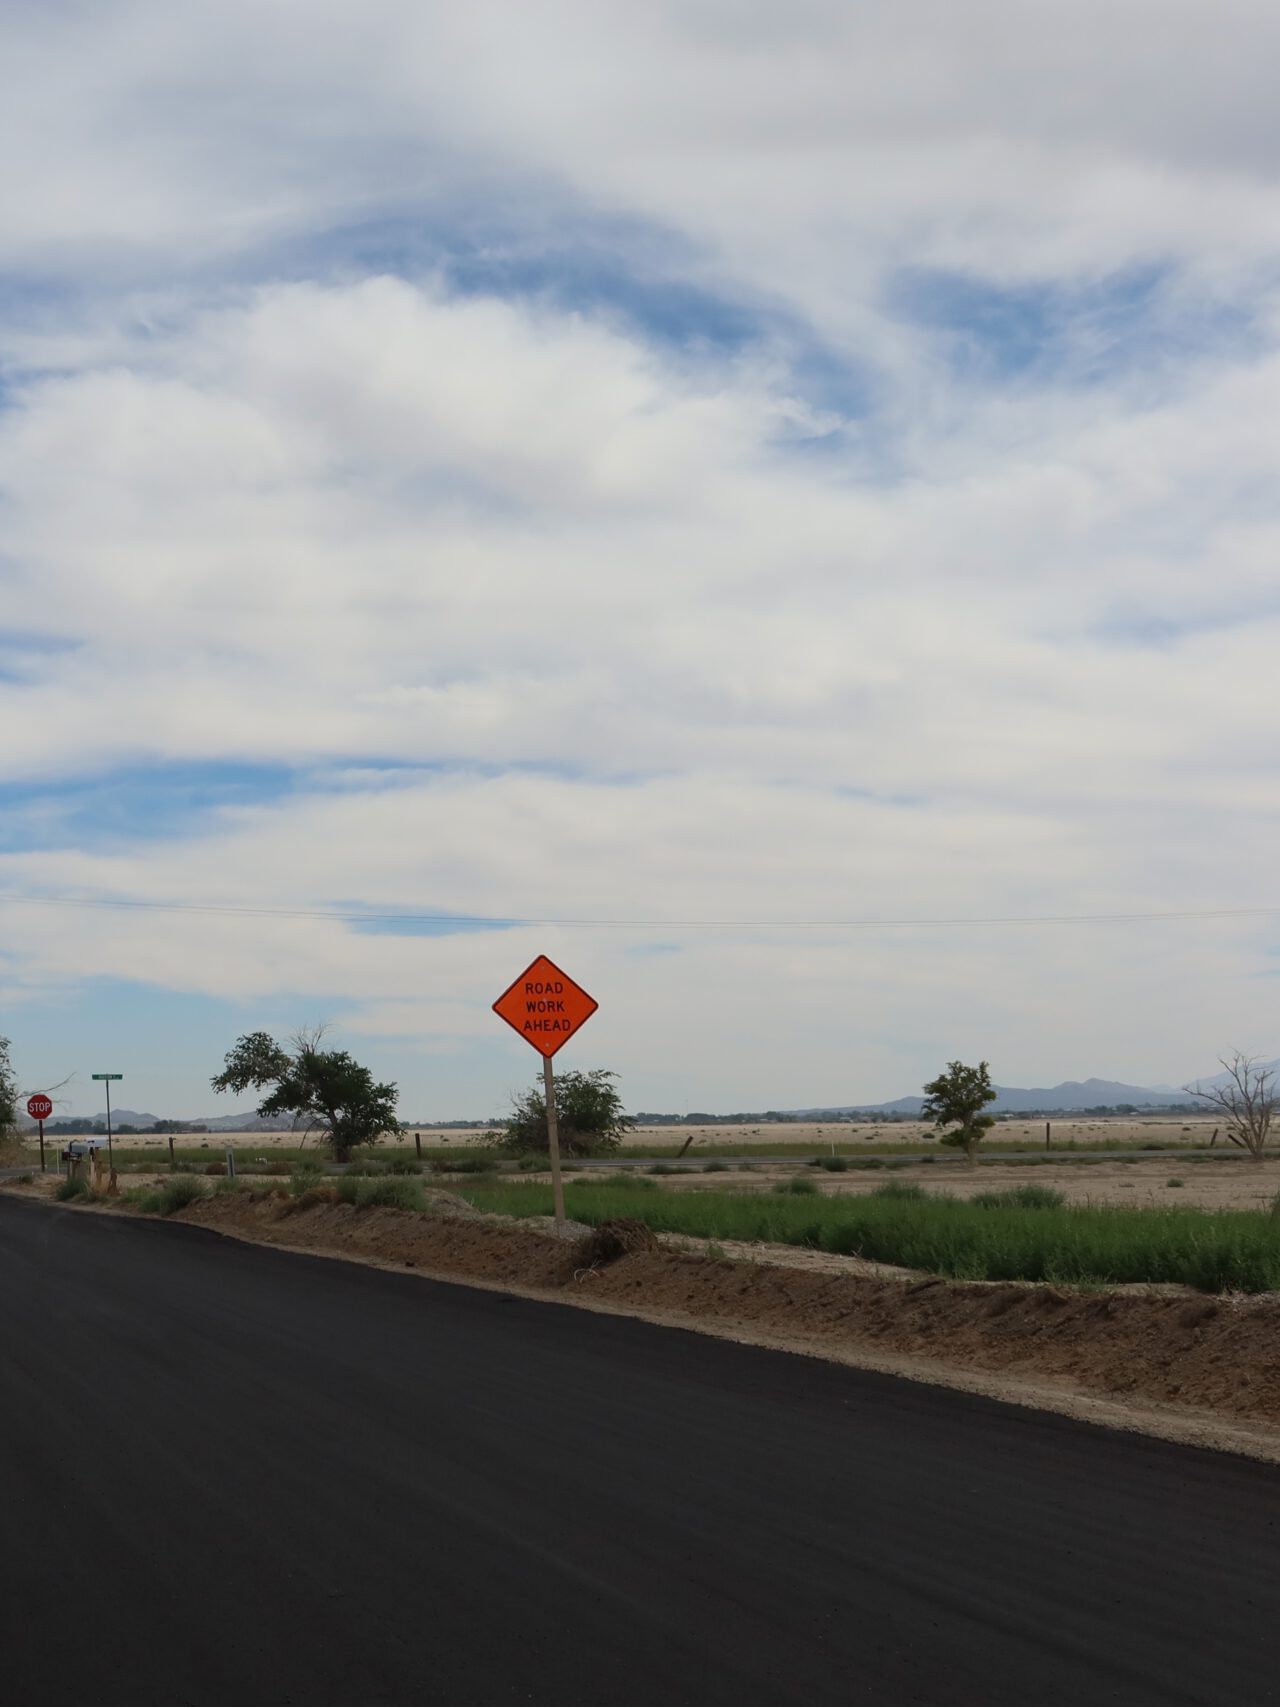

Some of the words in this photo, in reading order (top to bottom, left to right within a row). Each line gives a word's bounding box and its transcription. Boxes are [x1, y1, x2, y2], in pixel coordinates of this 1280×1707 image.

[525, 982, 564, 994] ROAD
[526, 1001, 565, 1013] WORK
[523, 1019, 571, 1032] AHEAD
[29, 1102, 50, 1112] STOP
